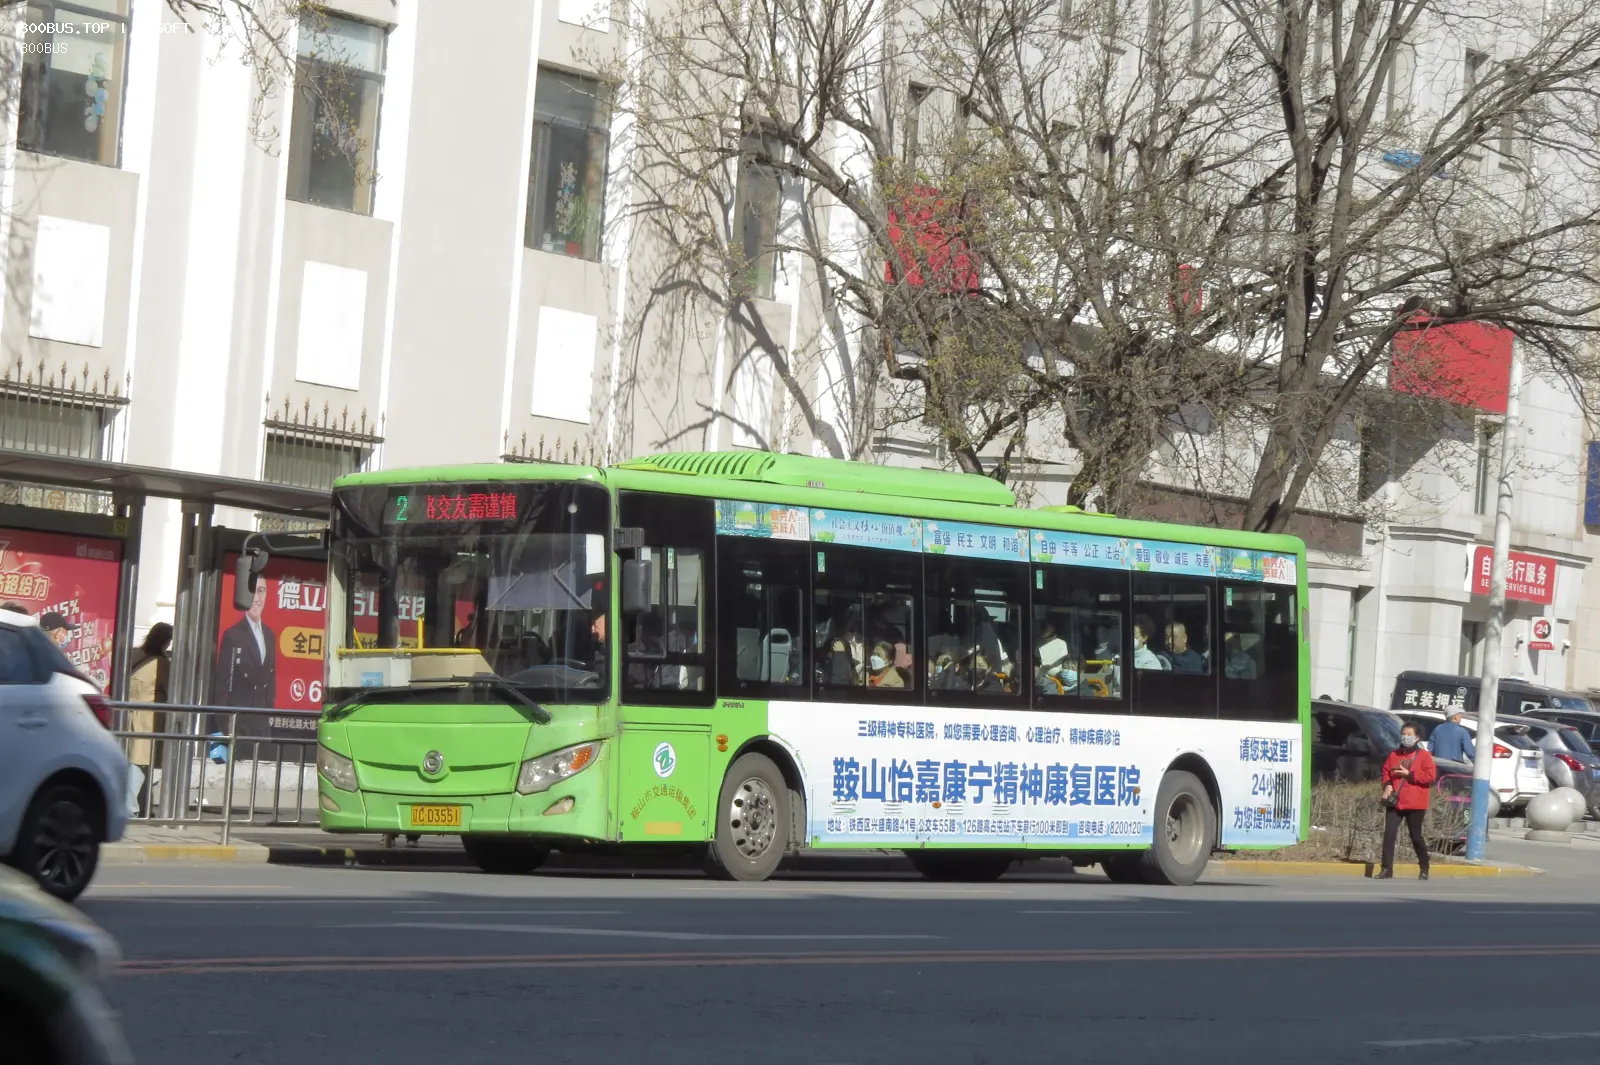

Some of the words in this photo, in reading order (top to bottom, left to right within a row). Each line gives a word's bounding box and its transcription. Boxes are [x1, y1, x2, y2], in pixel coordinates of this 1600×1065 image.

[396, 495, 408, 521] 2
[933, 530, 951, 546] 富强
[957, 533, 974, 549] 民主
[980, 535, 997, 551] 文明
[1002, 537, 1019, 553] 和谐
[1040, 540, 1057, 555] 自由
[1062, 541, 1079, 557] 平等
[1083, 543, 1100, 559] 公正
[1104, 545, 1121, 561] 法治
[1135, 549, 1151, 563] 爱国
[1155, 550, 1170, 565] 敬业
[1174, 552, 1189, 567] 诚信
[1195, 553, 1210, 568] 友善
[1481, 555, 1548, 586] 自银行服务
[277, 577, 327, 612] 德立
[1505, 582, 1528, 594] ERVICE
[1528, 586, 1546, 597] BANK
[1535, 623, 1549, 635] 24
[308, 681, 322, 702] 6
[274, 716, 319, 731] 胜利北路大馆
[832, 757, 1141, 807] 鞍山怡嘉康宁精神康复医院
